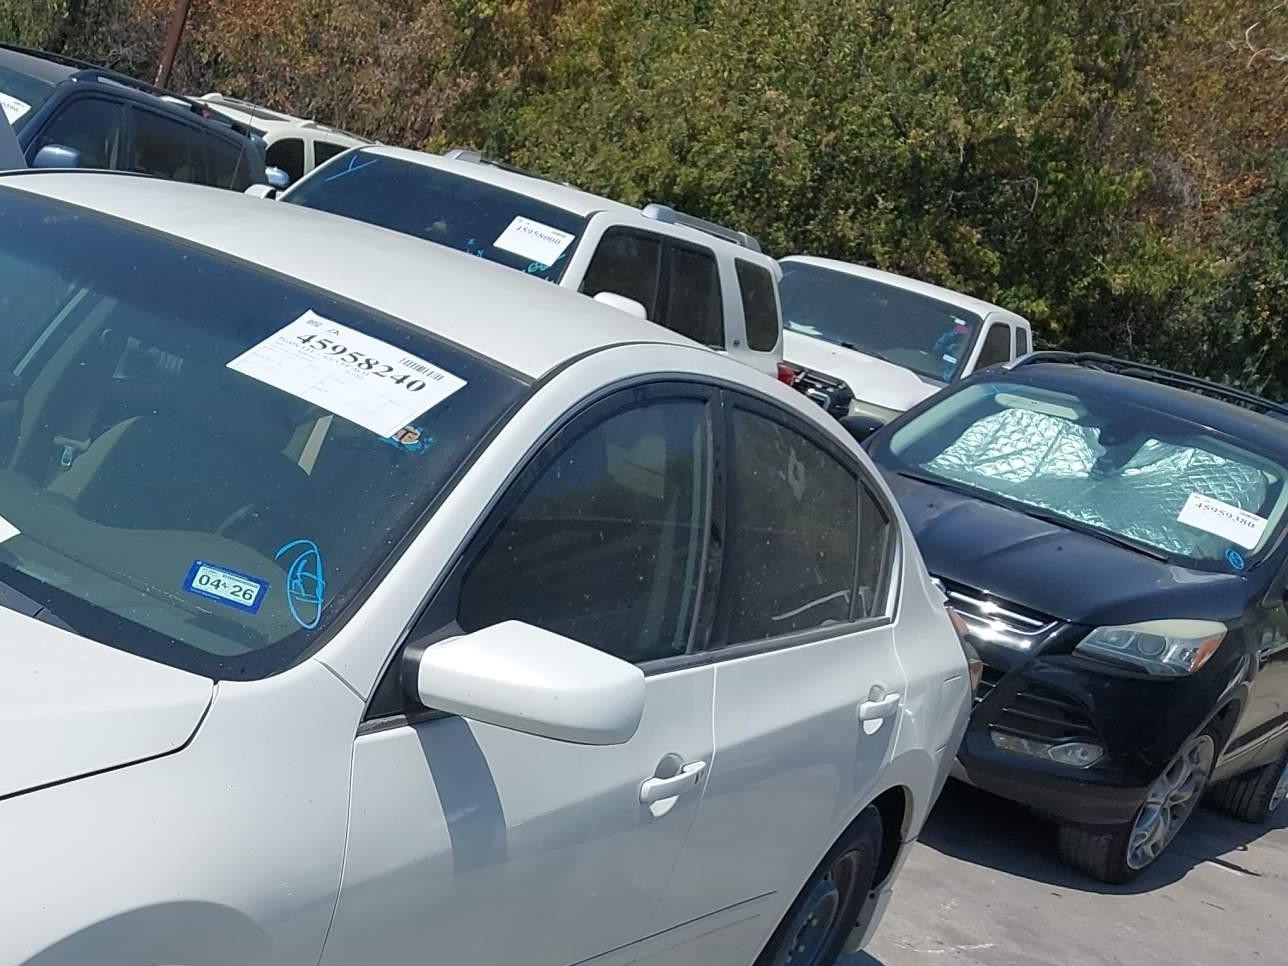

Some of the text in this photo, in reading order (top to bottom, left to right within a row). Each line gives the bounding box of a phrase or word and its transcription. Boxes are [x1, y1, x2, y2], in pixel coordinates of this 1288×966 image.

[297, 333, 427, 393] 45958240
[198, 574, 222, 590] 04
[230, 585, 254, 601] 26
